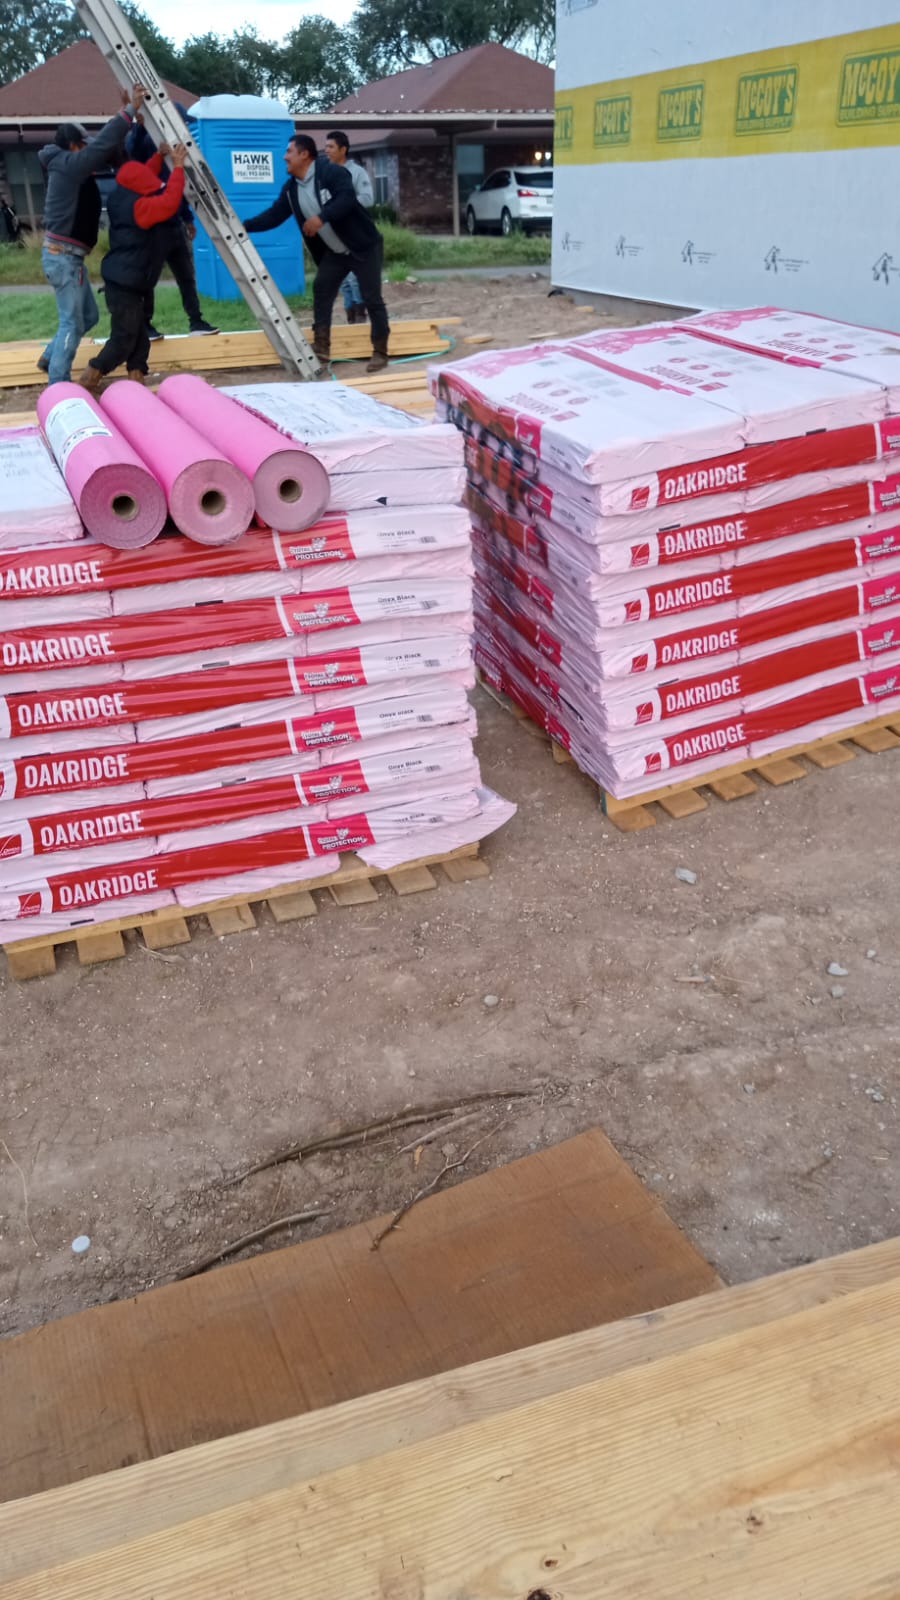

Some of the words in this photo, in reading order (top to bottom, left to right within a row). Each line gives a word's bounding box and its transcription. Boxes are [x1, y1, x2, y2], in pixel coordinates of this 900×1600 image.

[234, 154, 269, 164] HAWK
[665, 462, 748, 499] OAKRIDGE
[664, 519, 746, 555] OAKRIDGE
[295, 549, 342, 561] PROTECTION
[655, 574, 733, 612] OAKRIDGE
[300, 615, 347, 627] PROTECTION
[3, 632, 115, 666] OAKRIDGE
[661, 628, 739, 664] OAKRIDGE
[309, 674, 354, 687] PROTECTION
[666, 675, 741, 712] OAKRIDGE
[18, 692, 128, 727] OAKRIDGE
[306, 733, 349, 746] PROTECTION
[673, 723, 746, 761] OAKRIDGE
[24, 753, 129, 788] OAKRIDGE
[315, 786, 357, 798] PROTECTION
[40, 810, 144, 847] OAKRIDGE
[322, 837, 364, 850] PROTECTION
[59, 869, 158, 906] OAKRIDGE
